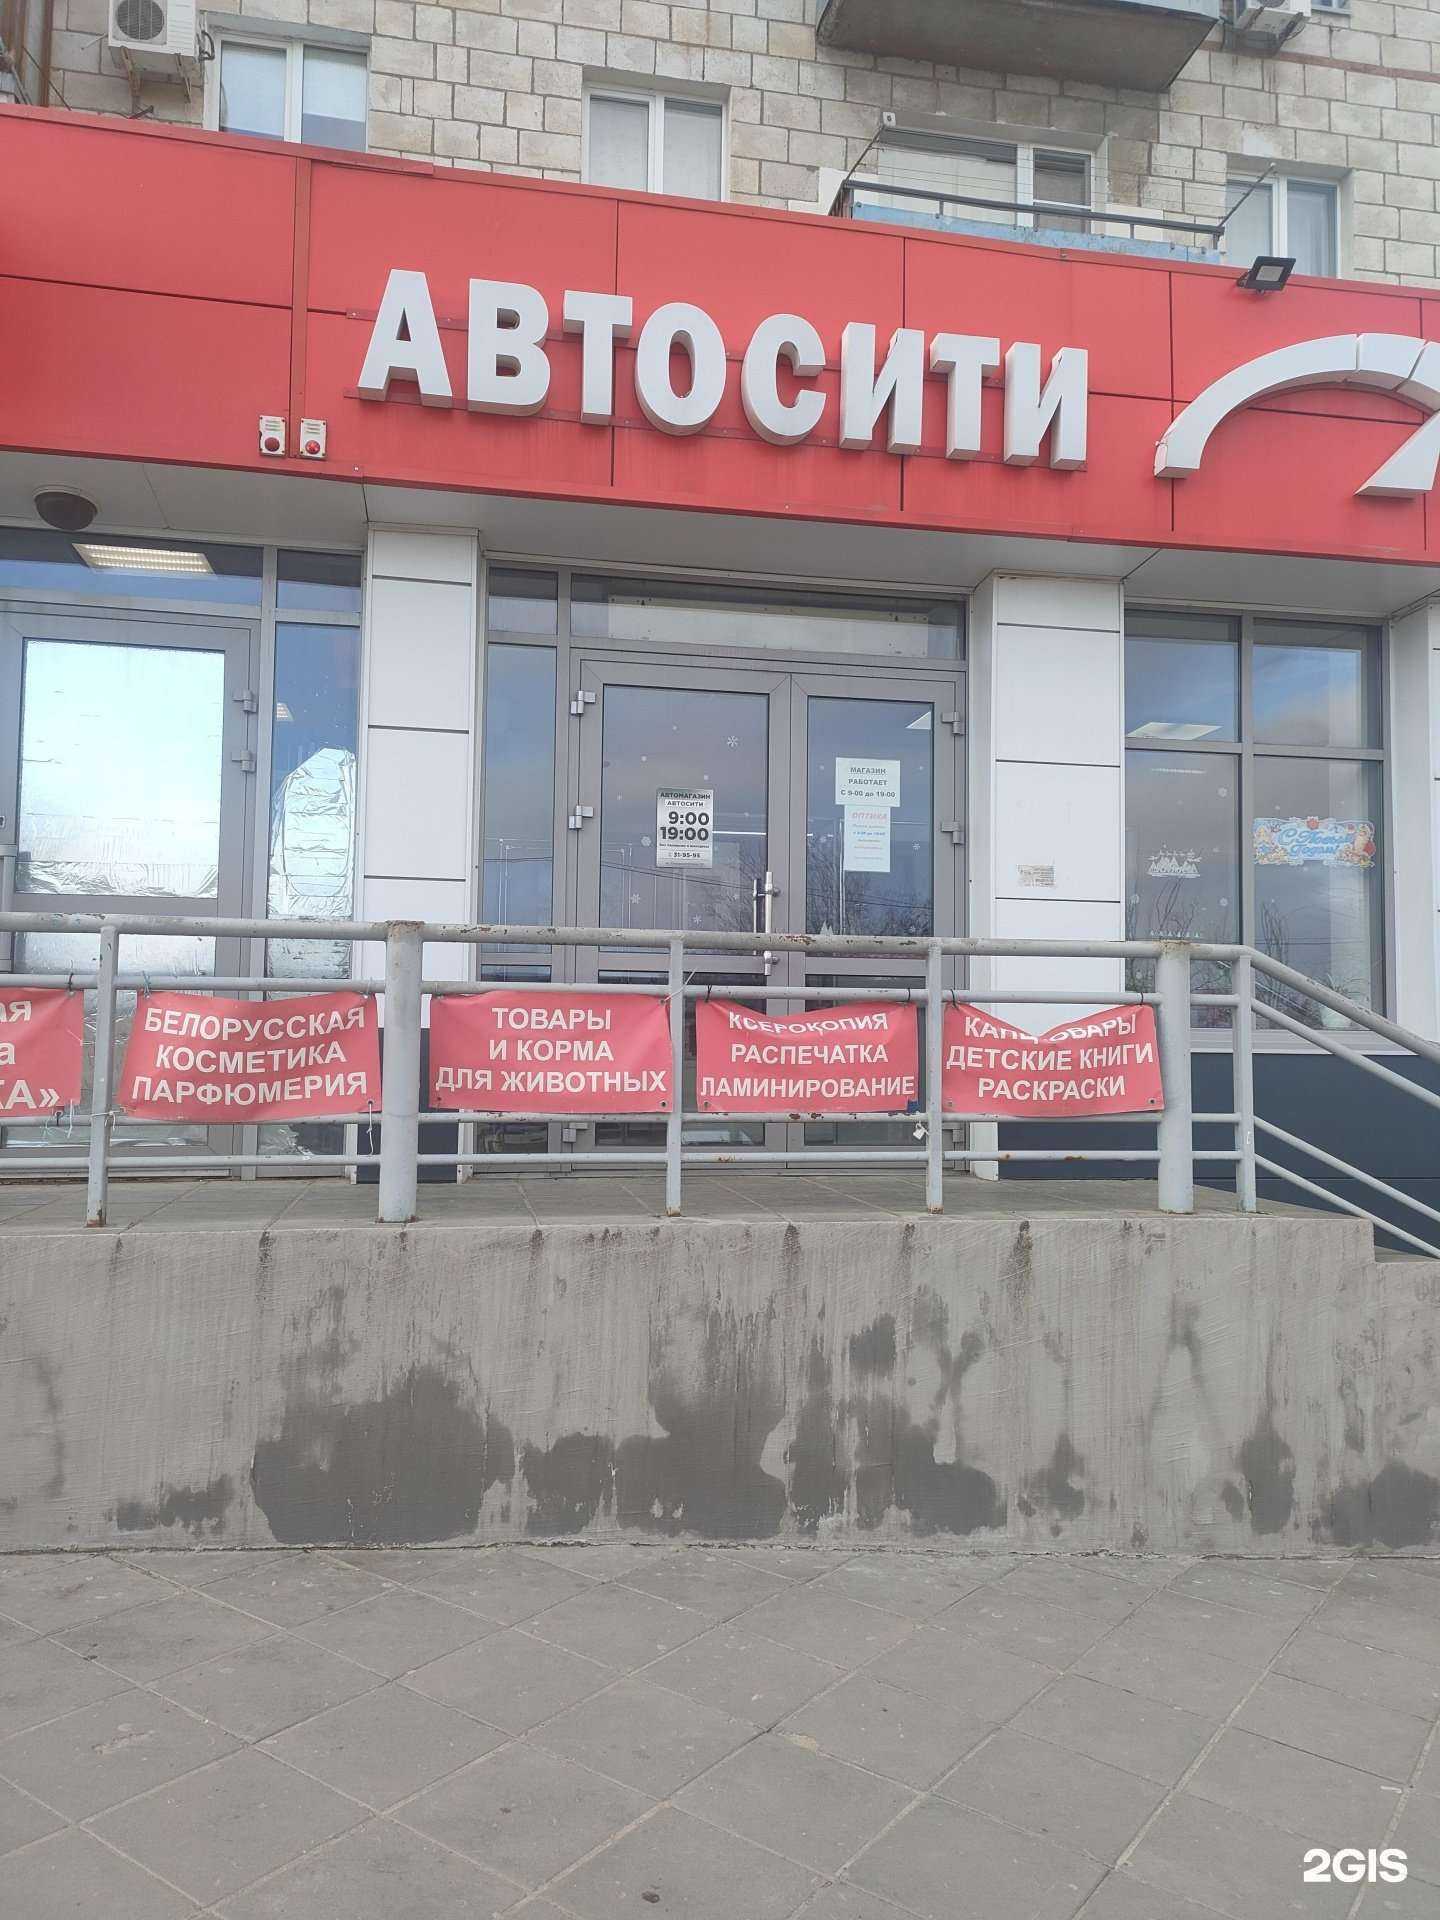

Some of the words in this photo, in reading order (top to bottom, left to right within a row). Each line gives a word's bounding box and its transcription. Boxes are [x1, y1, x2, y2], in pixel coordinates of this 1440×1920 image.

[357, 269, 1090, 471] АВТОСИТИ
[660, 792, 711, 800] АВТОМАГАЗИН
[668, 811, 710, 826] 9:00
[660, 826, 709, 841] 19:00
[144, 1006, 364, 1041] БЕЛОРУССКАЯ
[491, 1007, 611, 1030] ТОВАРЫ
[729, 1011, 888, 1036] КСЕРОКОПИЯ
[156, 1040, 346, 1074] КОСМЕТИКА
[489, 1039, 506, 1061] И
[517, 1039, 614, 1062] КОРМА
[731, 1043, 889, 1065] РАСПЕЧАТКА
[946, 1045, 1072, 1070] ДЕТСКИЕ
[1079, 1042, 1154, 1070] КНИГИ
[132, 1071, 367, 1106] ПАРФЮМЕРИЯ
[435, 1066, 492, 1092] ДЛЯ
[500, 1070, 667, 1093] ЖИВОТНЫХ
[700, 1075, 915, 1098] ЛАМИНИРОВАНИЕ
[978, 1075, 1126, 1101] РАСКРАСКИ
